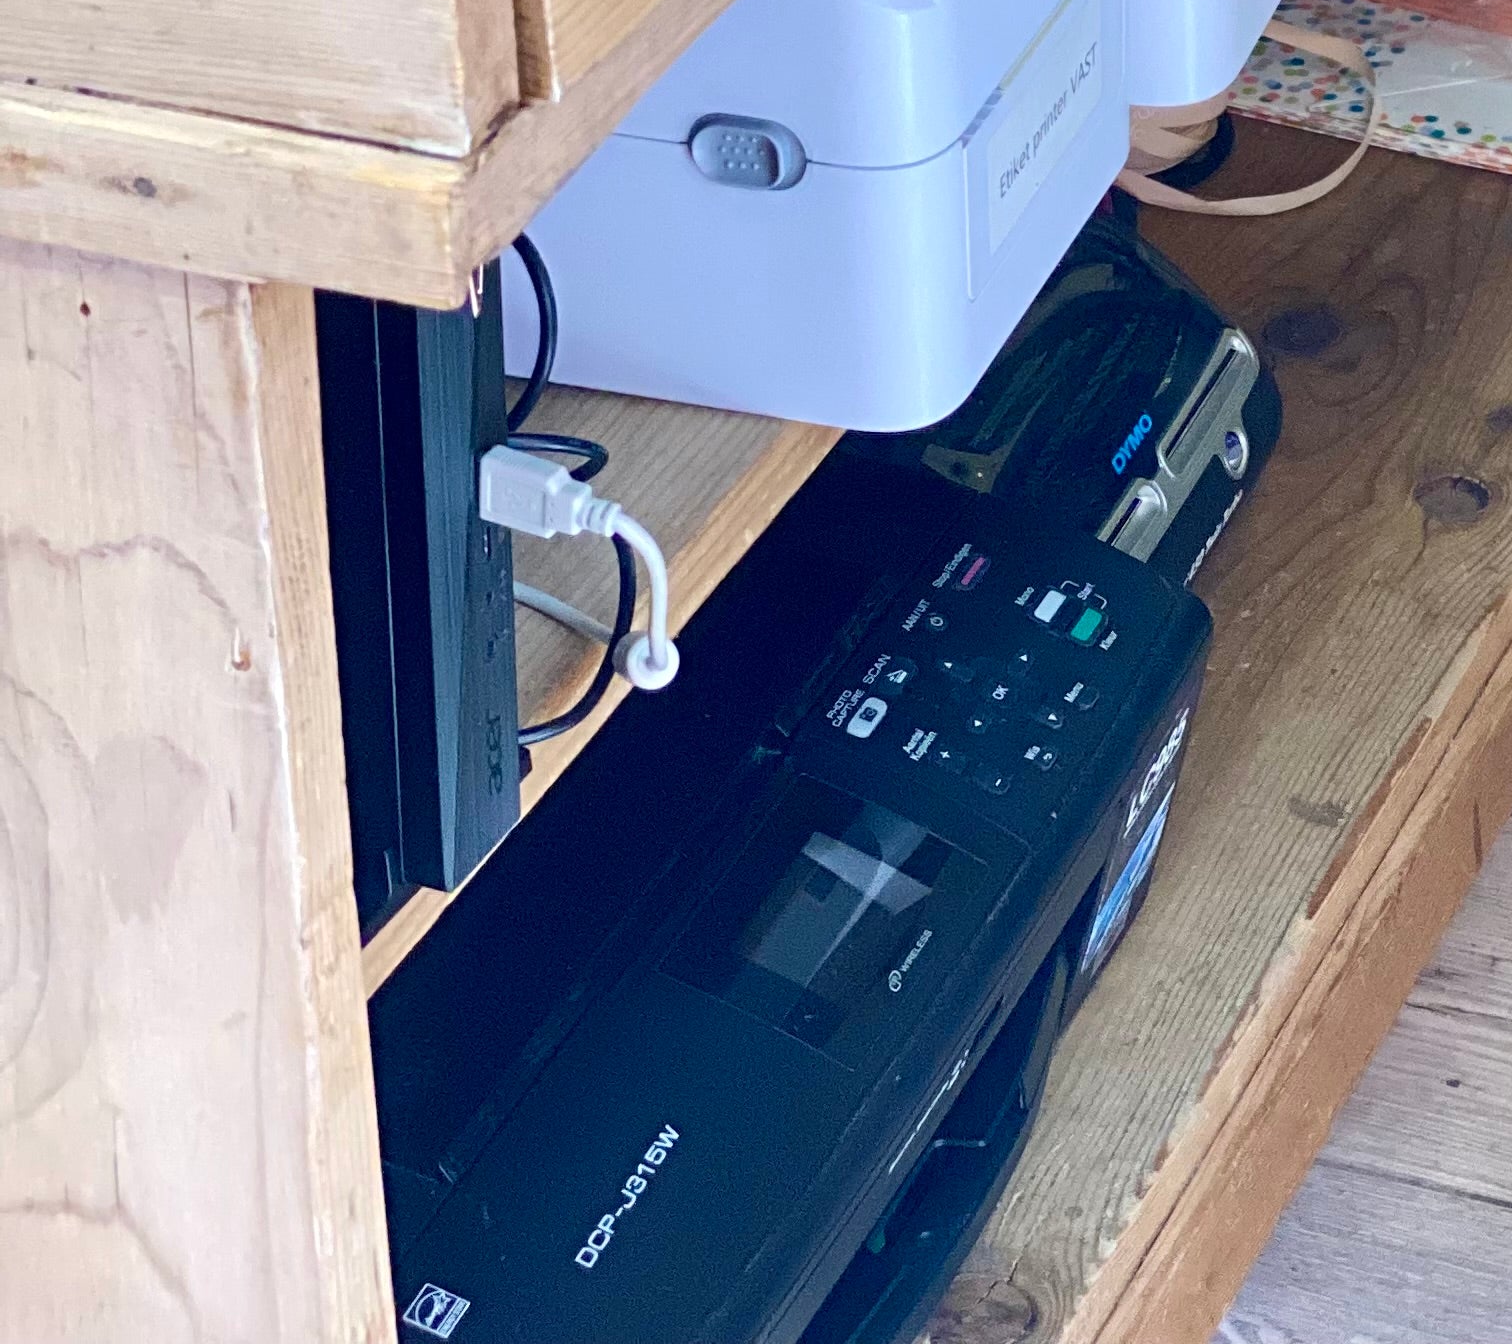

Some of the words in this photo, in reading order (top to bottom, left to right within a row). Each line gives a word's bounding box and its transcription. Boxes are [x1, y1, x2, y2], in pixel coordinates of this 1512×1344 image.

[999, 142, 1030, 199] Etiket
[1032, 90, 1068, 157] printer
[1069, 41, 1097, 94] VAST
[1111, 413, 1153, 475] DYMO
[1014, 586, 1035, 607] Mono
[1077, 582, 1096, 601] Start
[1099, 630, 1118, 651] Kleur
[862, 653, 892, 685] SCAN
[826, 689, 853, 720] PHOTO
[831, 688, 866, 728] CAPTURE
[992, 684, 1009, 701] OK
[1063, 682, 1085, 703] Menu
[1023, 745, 1041, 761] Wis
[900, 929, 933, 973] WIRELESS
[574, 1124, 680, 1269] DCP-J315W
